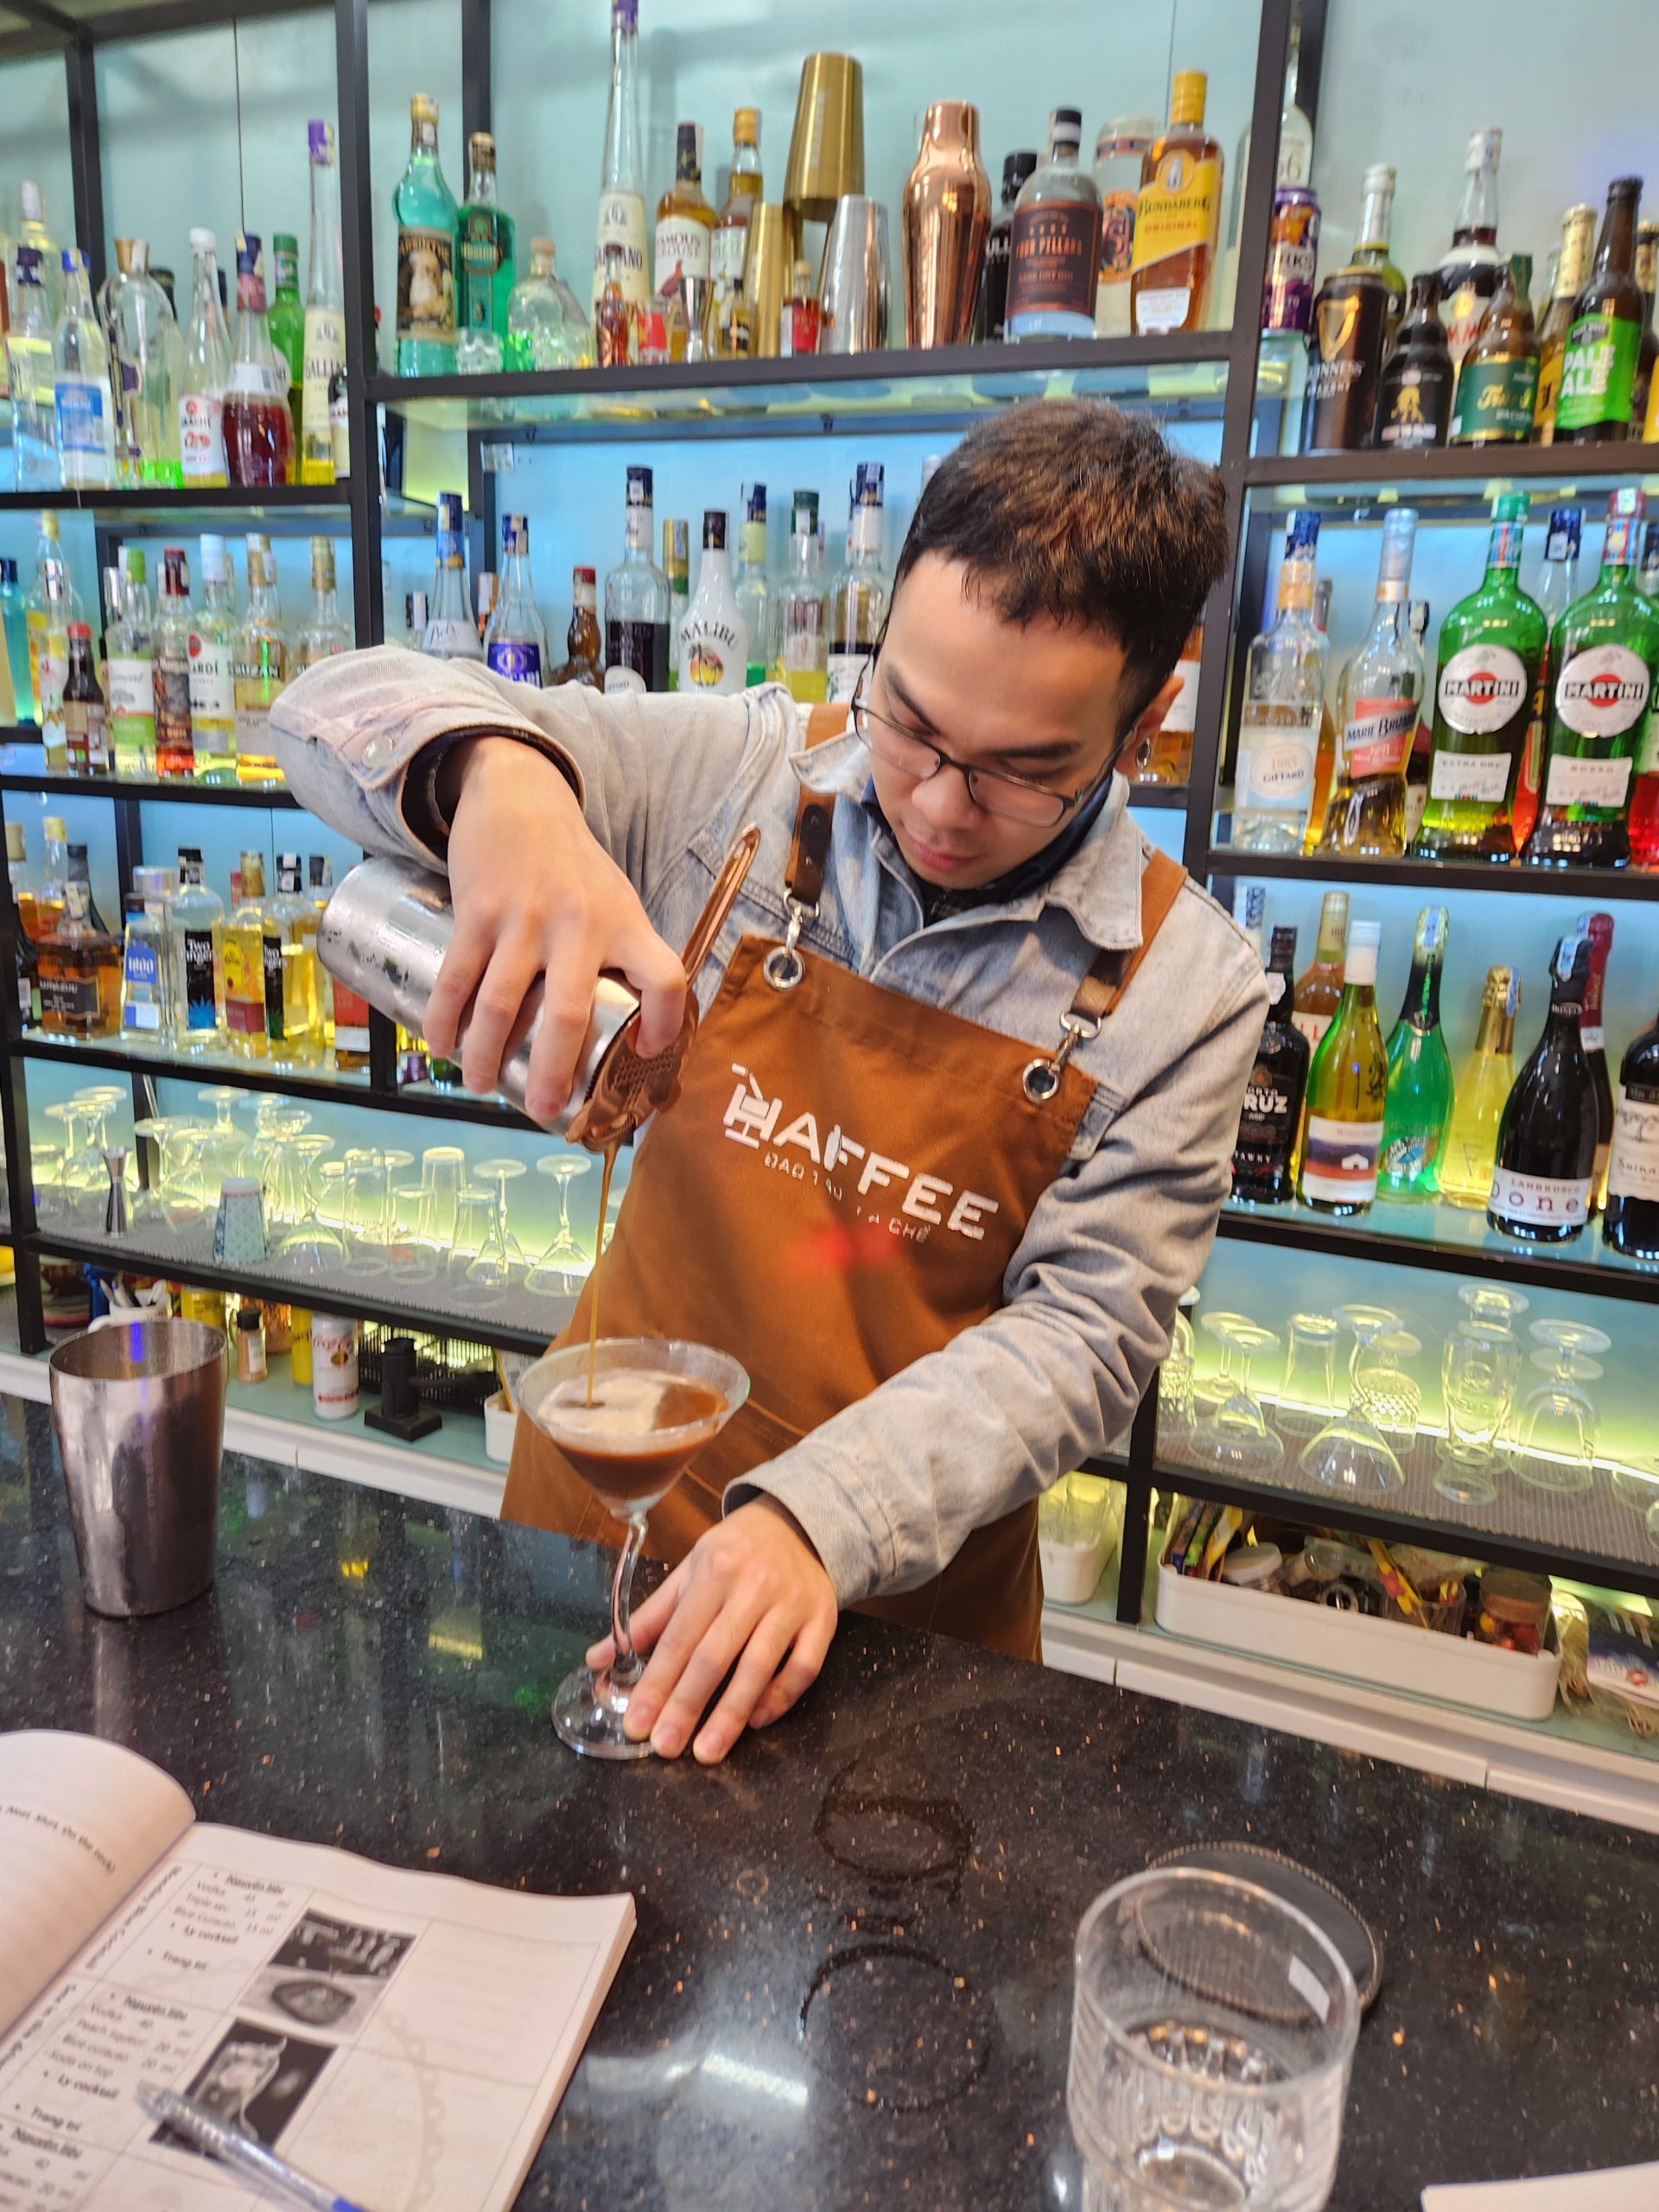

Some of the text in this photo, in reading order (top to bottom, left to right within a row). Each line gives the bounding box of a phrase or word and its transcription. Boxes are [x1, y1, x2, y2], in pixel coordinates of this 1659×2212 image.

[1140, 197, 1211, 217] BUNDABERG
[1563, 344, 1615, 374] PALE
[1560, 366, 1609, 398] ALE
[680, 620, 738, 651] MALIBU
[1445, 680, 1520, 697] MARTINI
[1565, 682, 1644, 700] MARTINI
[1346, 728, 1374, 742] MARIE
[1262, 769, 1304, 783] GIFFARD
[1571, 765, 1613, 774] ROSSO
[188, 938, 210, 951] Two
[263, 944, 279, 957] Two
[1243, 1094, 1288, 1114] RUZ
[723, 1081, 999, 1241] HAFFEE
